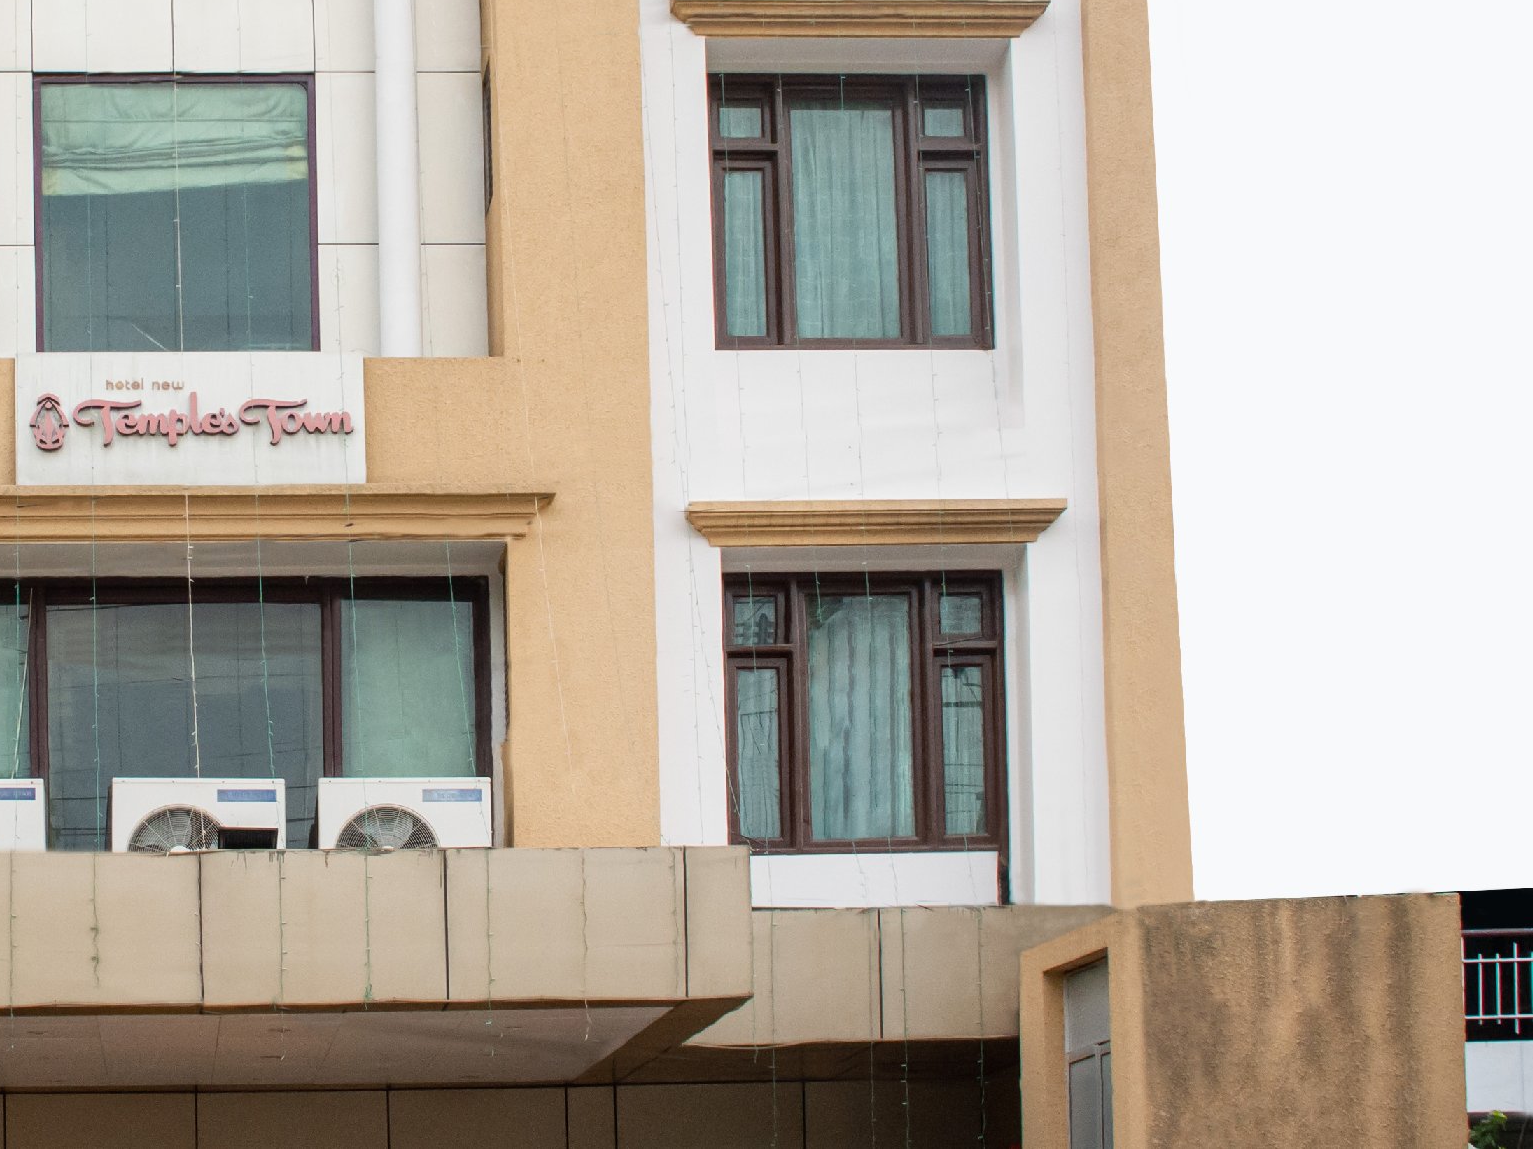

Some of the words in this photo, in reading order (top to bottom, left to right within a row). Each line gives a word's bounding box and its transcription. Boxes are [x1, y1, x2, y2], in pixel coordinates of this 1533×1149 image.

[105, 378, 145, 391] hotel
[151, 381, 185, 391] new
[72, 391, 241, 447] Temple's
[239, 398, 355, 446] Town
